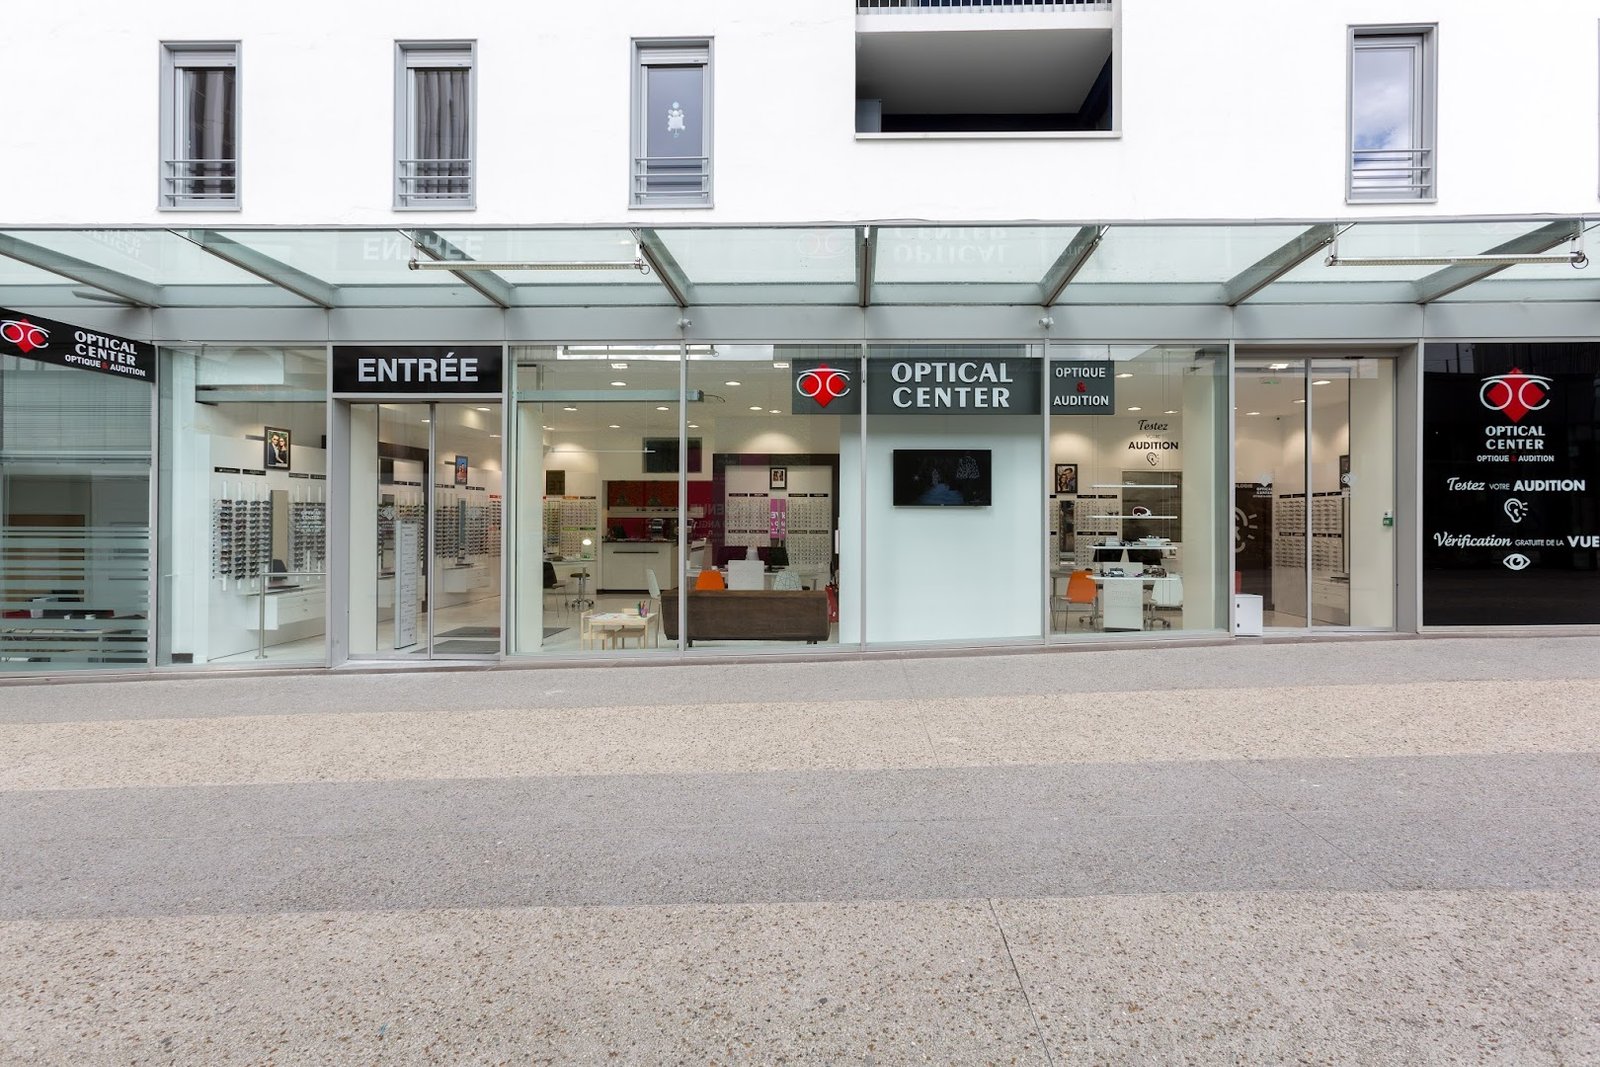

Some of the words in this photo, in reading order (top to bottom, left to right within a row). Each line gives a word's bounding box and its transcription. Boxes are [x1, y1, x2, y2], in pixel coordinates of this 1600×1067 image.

[74, 330, 138, 355] OPTICAL
[75, 343, 136, 367] CENTER
[65, 354, 101, 368] OPTIQUE
[110, 365, 146, 377] AUDITION
[358, 352, 479, 382] ENTRÉE
[891, 362, 1013, 383] OPTICAL
[1055, 367, 1106, 378] OPTIQUE
[1076, 381, 1087, 393] &
[892, 387, 1010, 408] CENTER
[1053, 395, 1109, 406] AUDITION
[1137, 419, 1169, 431] Testez
[1485, 425, 1546, 437] OPTICAL
[1128, 441, 1179, 450] AUDITION
[1485, 439, 1544, 450] CENTER
[1476, 455, 1510, 463] OPTIQUE
[1446, 477, 1486, 491] Testez
[1488, 483, 1510, 491] VOTRE
[1513, 479, 1586, 492] AUDITION
[1433, 531, 1513, 549] Vérification
[1567, 535, 1600, 548] VUE
